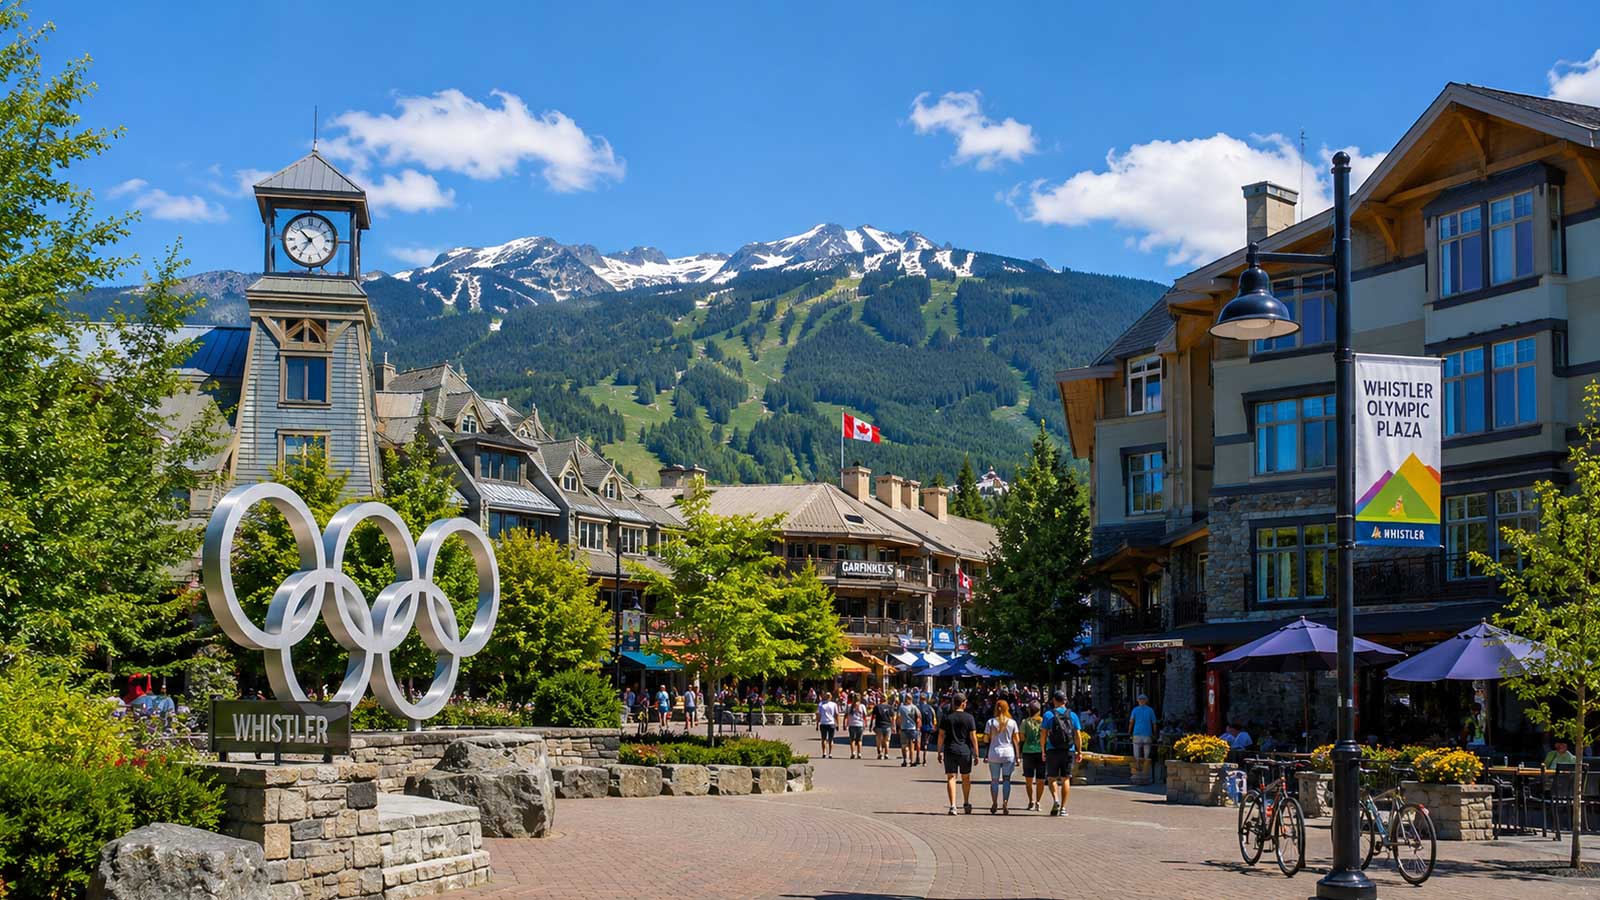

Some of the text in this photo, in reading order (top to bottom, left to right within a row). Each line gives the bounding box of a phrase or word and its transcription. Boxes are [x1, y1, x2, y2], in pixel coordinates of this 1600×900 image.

[1363, 379, 1433, 399] WHISTLER
[1367, 400, 1430, 419] OLYMPIC
[1377, 420, 1422, 439] PLAZA
[232, 713, 329, 744] WHISTLER
